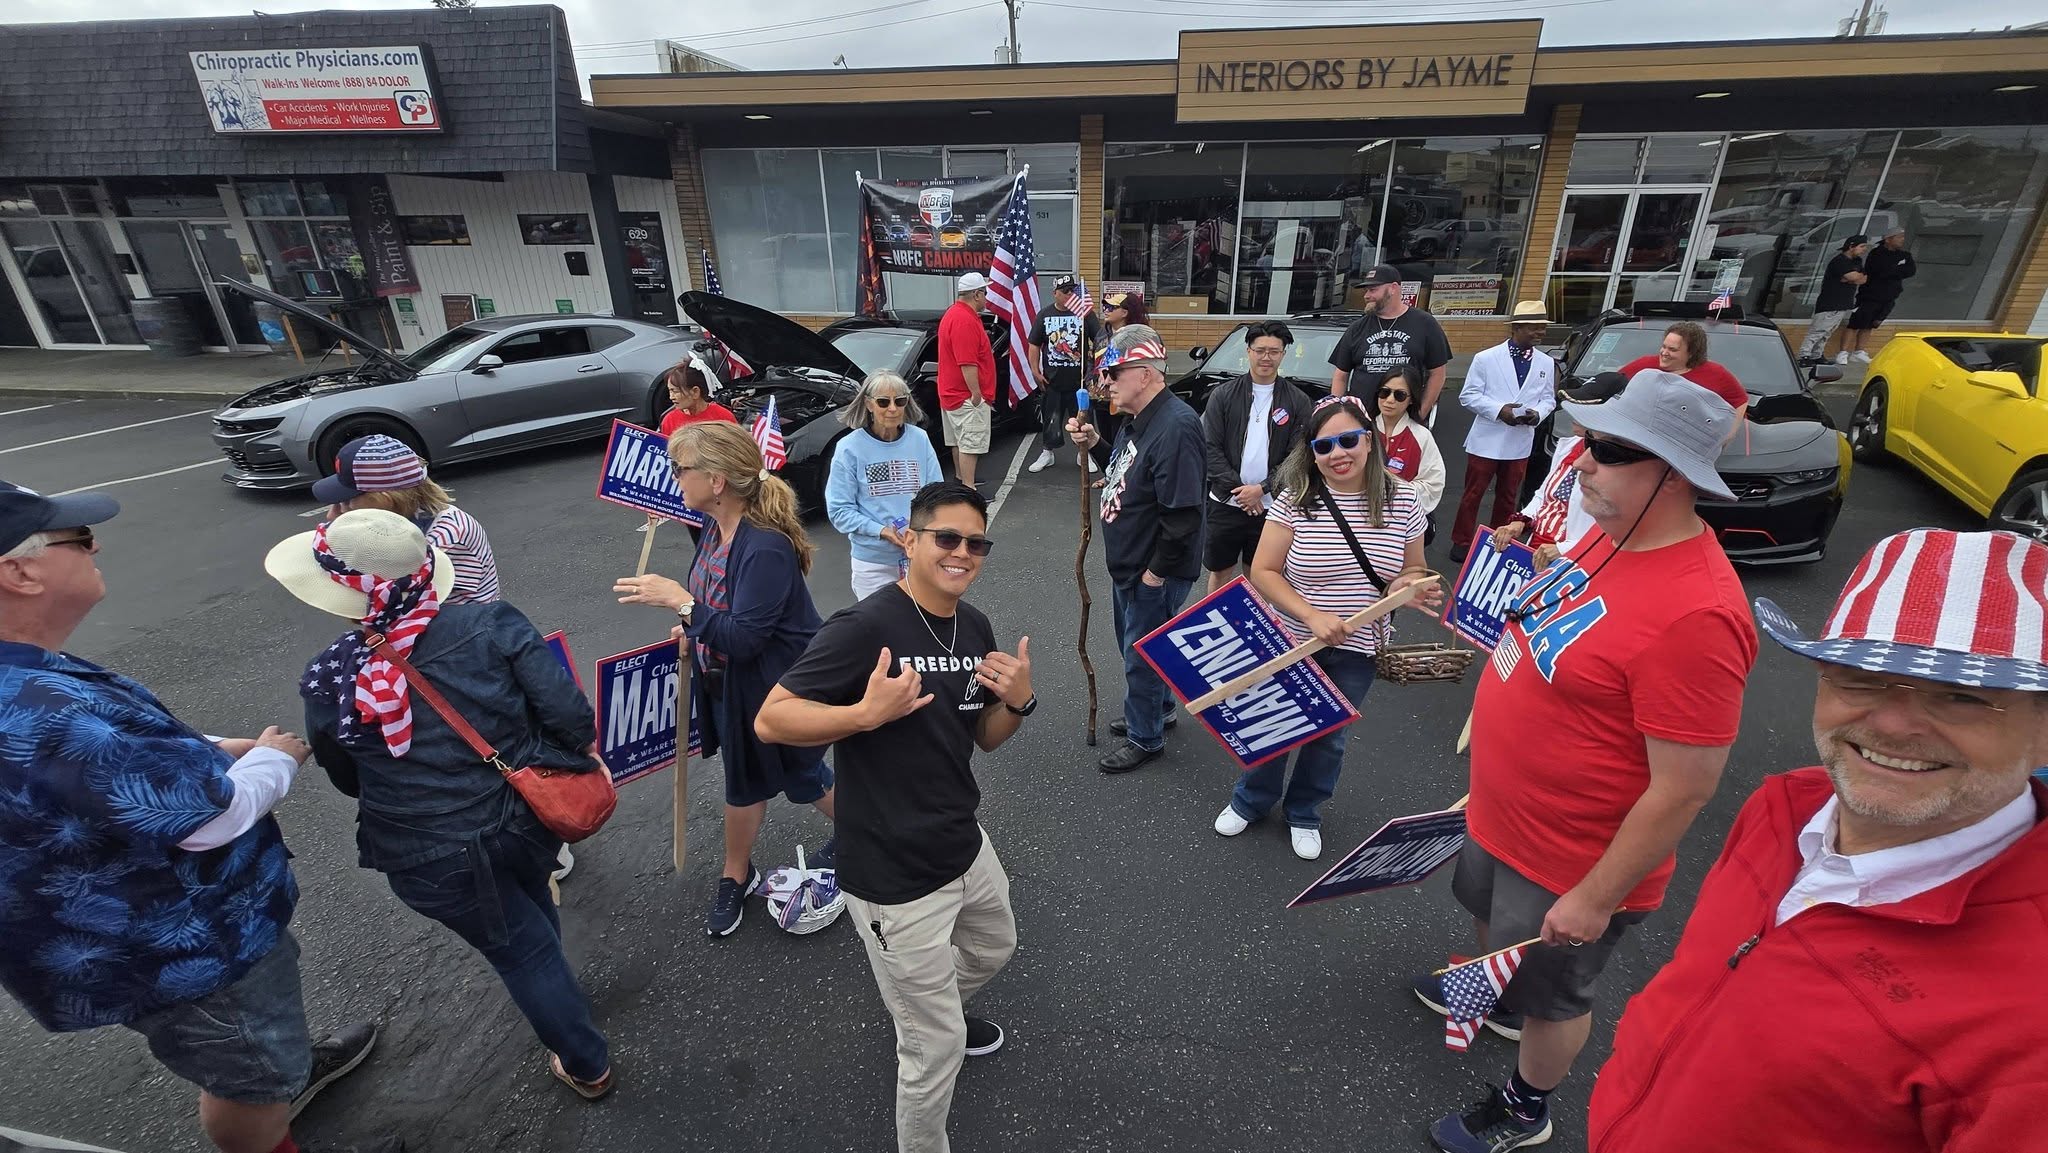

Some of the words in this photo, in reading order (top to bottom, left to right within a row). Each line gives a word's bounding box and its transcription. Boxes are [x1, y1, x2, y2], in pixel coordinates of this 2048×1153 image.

[196, 53, 291, 73] Chiropractic
[296, 51, 419, 72] Physicians.com
[261, 78, 299, 89] Walk-Ins
[300, 77, 340, 89] Welcome
[342, 76, 366, 89] (888)
[366, 76, 378, 87] 84
[379, 75, 411, 87] DOLOR
[1197, 59, 1345, 93] INTERIORS
[1356, 57, 1395, 89] BY
[1402, 55, 1514, 88] JAYME
[288, 102, 328, 113] Accidents
[338, 102, 357, 112] Work
[358, 101, 391, 114] Injuries
[309, 114, 342, 126] Medical
[349, 114, 387, 125] Wellness
[921, 194, 951, 208] NBFC
[377, 219, 393, 234] &
[628, 229, 649, 240] 629
[382, 239, 410, 285] Paint
[892, 249, 923, 268] NBFC
[924, 250, 993, 268] CAMAROS
[1434, 282, 1459, 290] INTERIORS
[1387, 329, 1411, 343] STATE
[624, 426, 649, 440] ELECT
[609, 491, 643, 505] WASHINGTON
[642, 501, 657, 510] STATE
[657, 506, 674, 514] HOUSE
[674, 510, 696, 520] DISTRICT
[629, 489, 639, 497] WE
[638, 493, 650, 501] ARE
[651, 496, 662, 504] THE
[661, 500, 684, 510] CHANGE
[1504, 558, 1533, 579] Chris
[1242, 597, 1253, 608] 33
[1249, 607, 1276, 634] DISTRICT
[1474, 619, 1483, 630] WE
[1482, 625, 1495, 636] ARE
[1511, 556, 1608, 685] USA
[614, 653, 650, 674] ELECT
[651, 659, 681, 677] Chri
[1288, 670, 1304, 686] ARE
[1300, 680, 1313, 697] WE
[1305, 672, 1342, 712] WASHINGTON
[654, 742, 669, 754] ARE
[1219, 731, 1249, 757] ELECT
[611, 755, 660, 780] WASHINGTON
